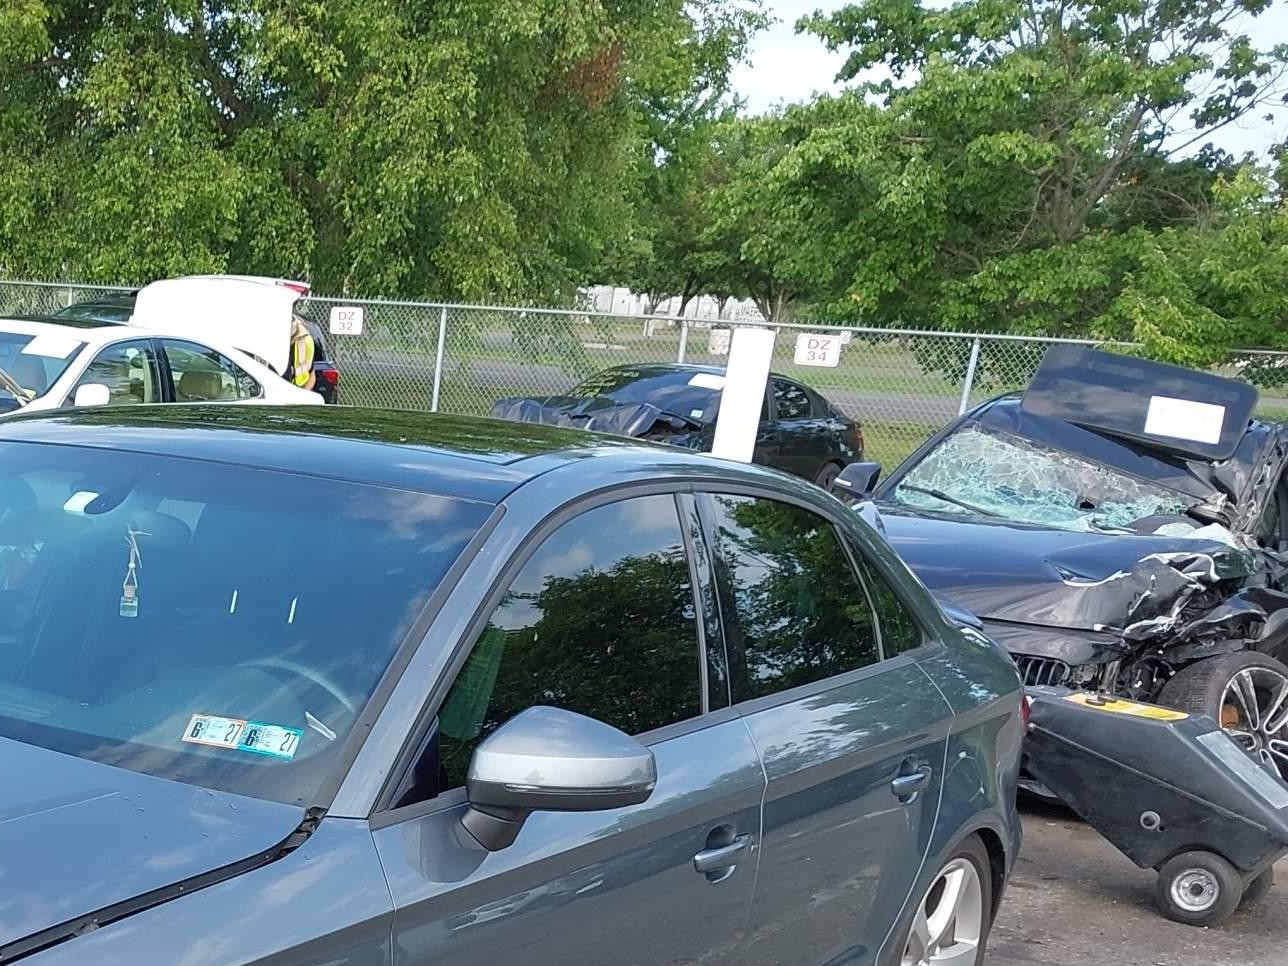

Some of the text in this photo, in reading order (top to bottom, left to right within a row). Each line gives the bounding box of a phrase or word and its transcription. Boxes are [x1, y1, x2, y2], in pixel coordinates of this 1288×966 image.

[338, 311, 355, 321] DZ
[338, 321, 354, 331] 32
[807, 338, 831, 350] DZ
[807, 350, 826, 361] 34
[223, 723, 242, 744] 27
[279, 732, 297, 753] 27
